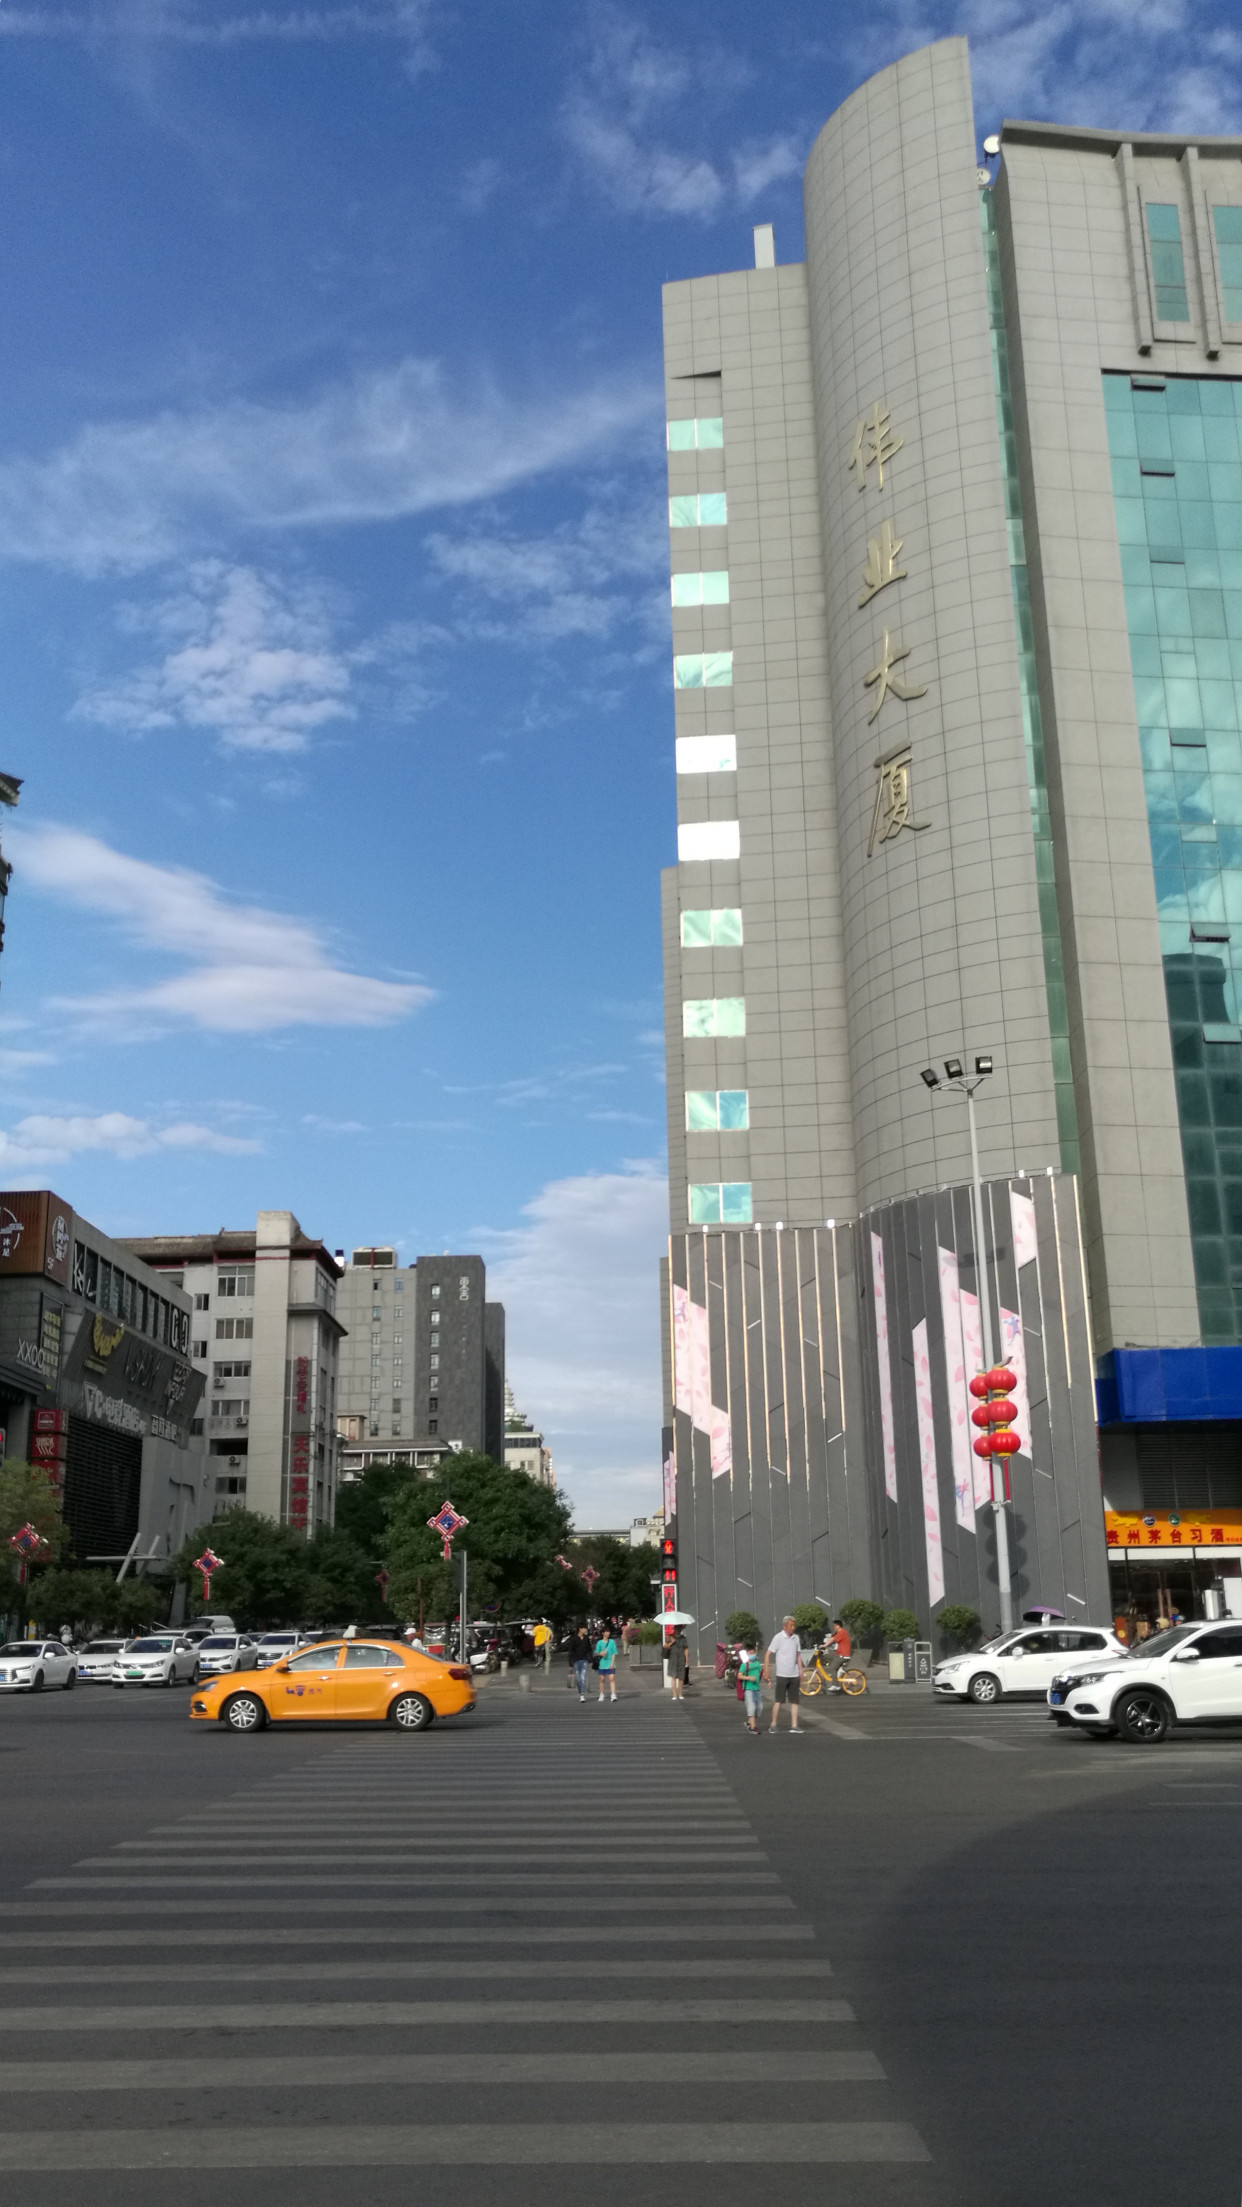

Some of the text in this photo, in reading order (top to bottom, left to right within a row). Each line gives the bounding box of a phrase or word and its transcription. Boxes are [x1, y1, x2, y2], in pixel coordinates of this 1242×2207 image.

[848, 401, 933, 858] 伟业大厦
[1106, 1528, 1224, 1545] 贵州茅台习酒
